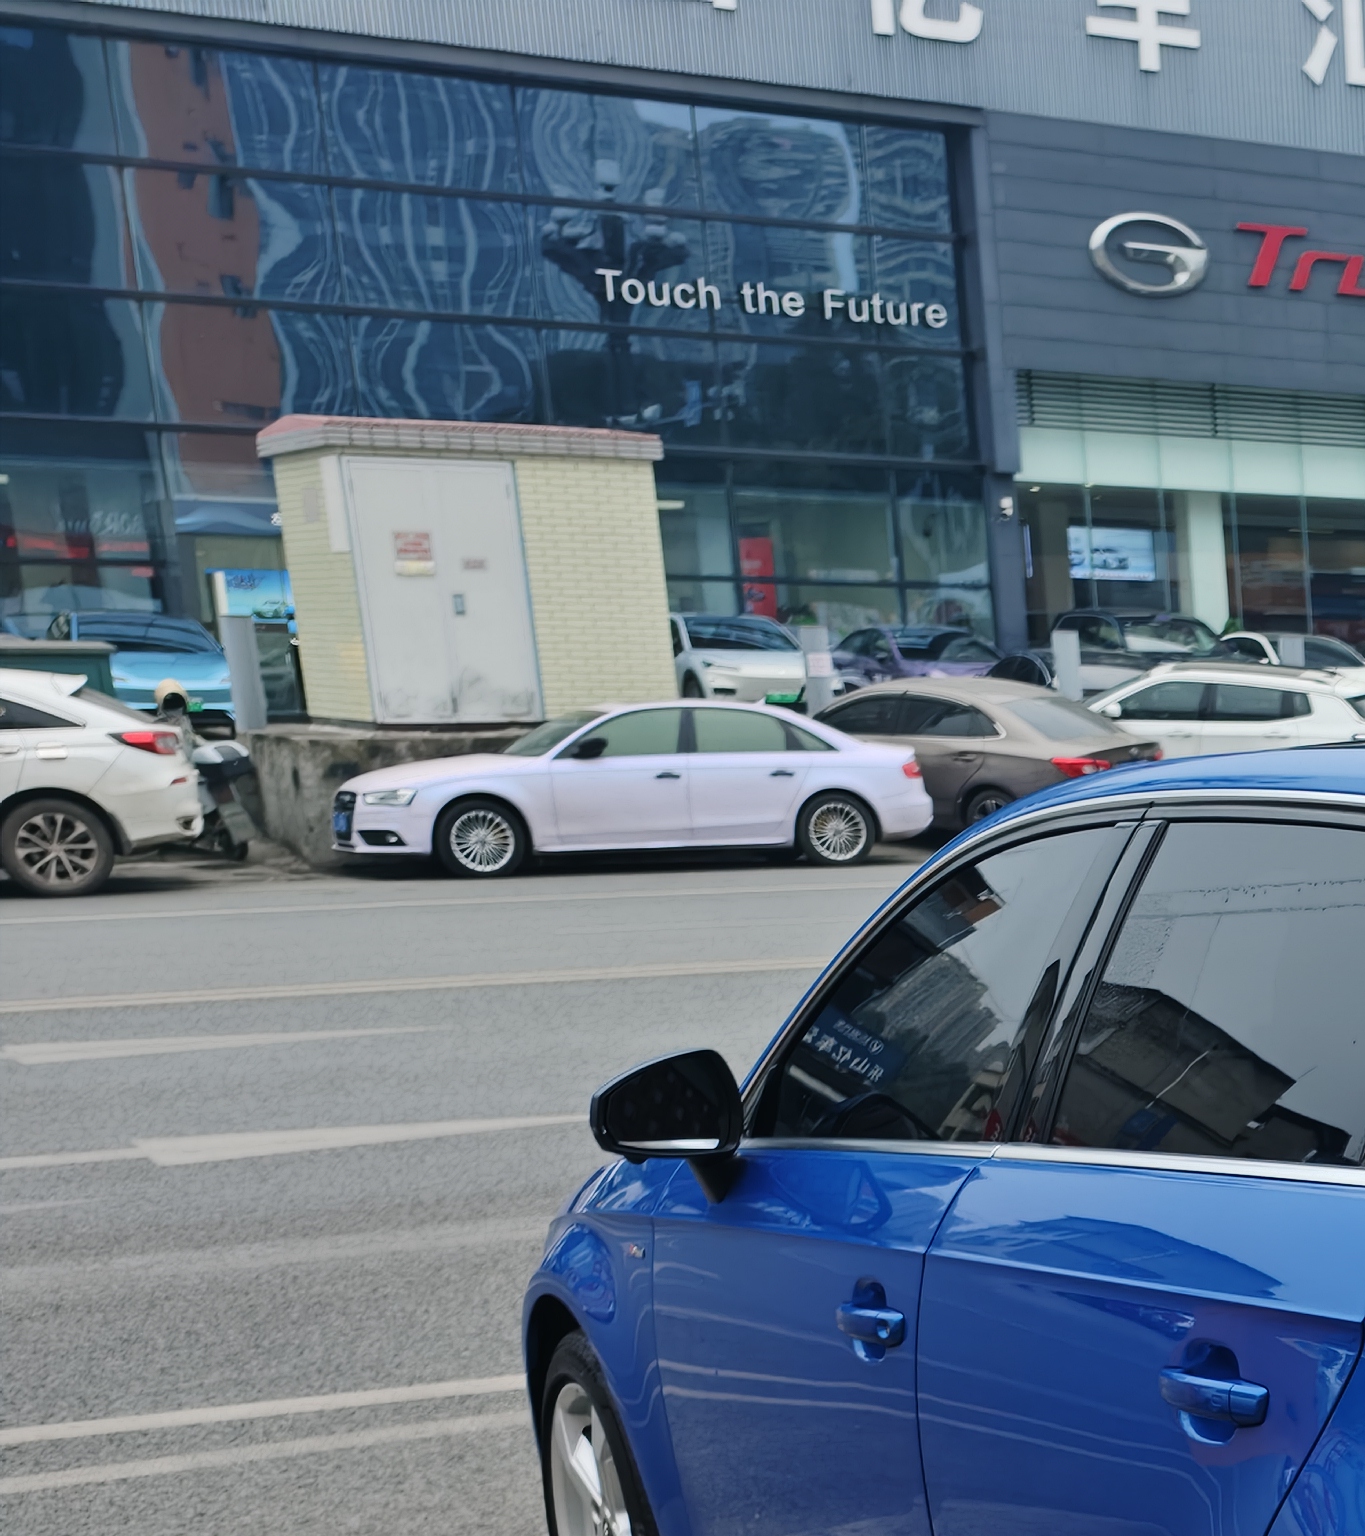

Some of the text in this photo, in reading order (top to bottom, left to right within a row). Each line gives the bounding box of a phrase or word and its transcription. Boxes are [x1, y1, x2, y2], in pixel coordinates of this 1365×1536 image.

[595, 268, 949, 330] Touch the Future
